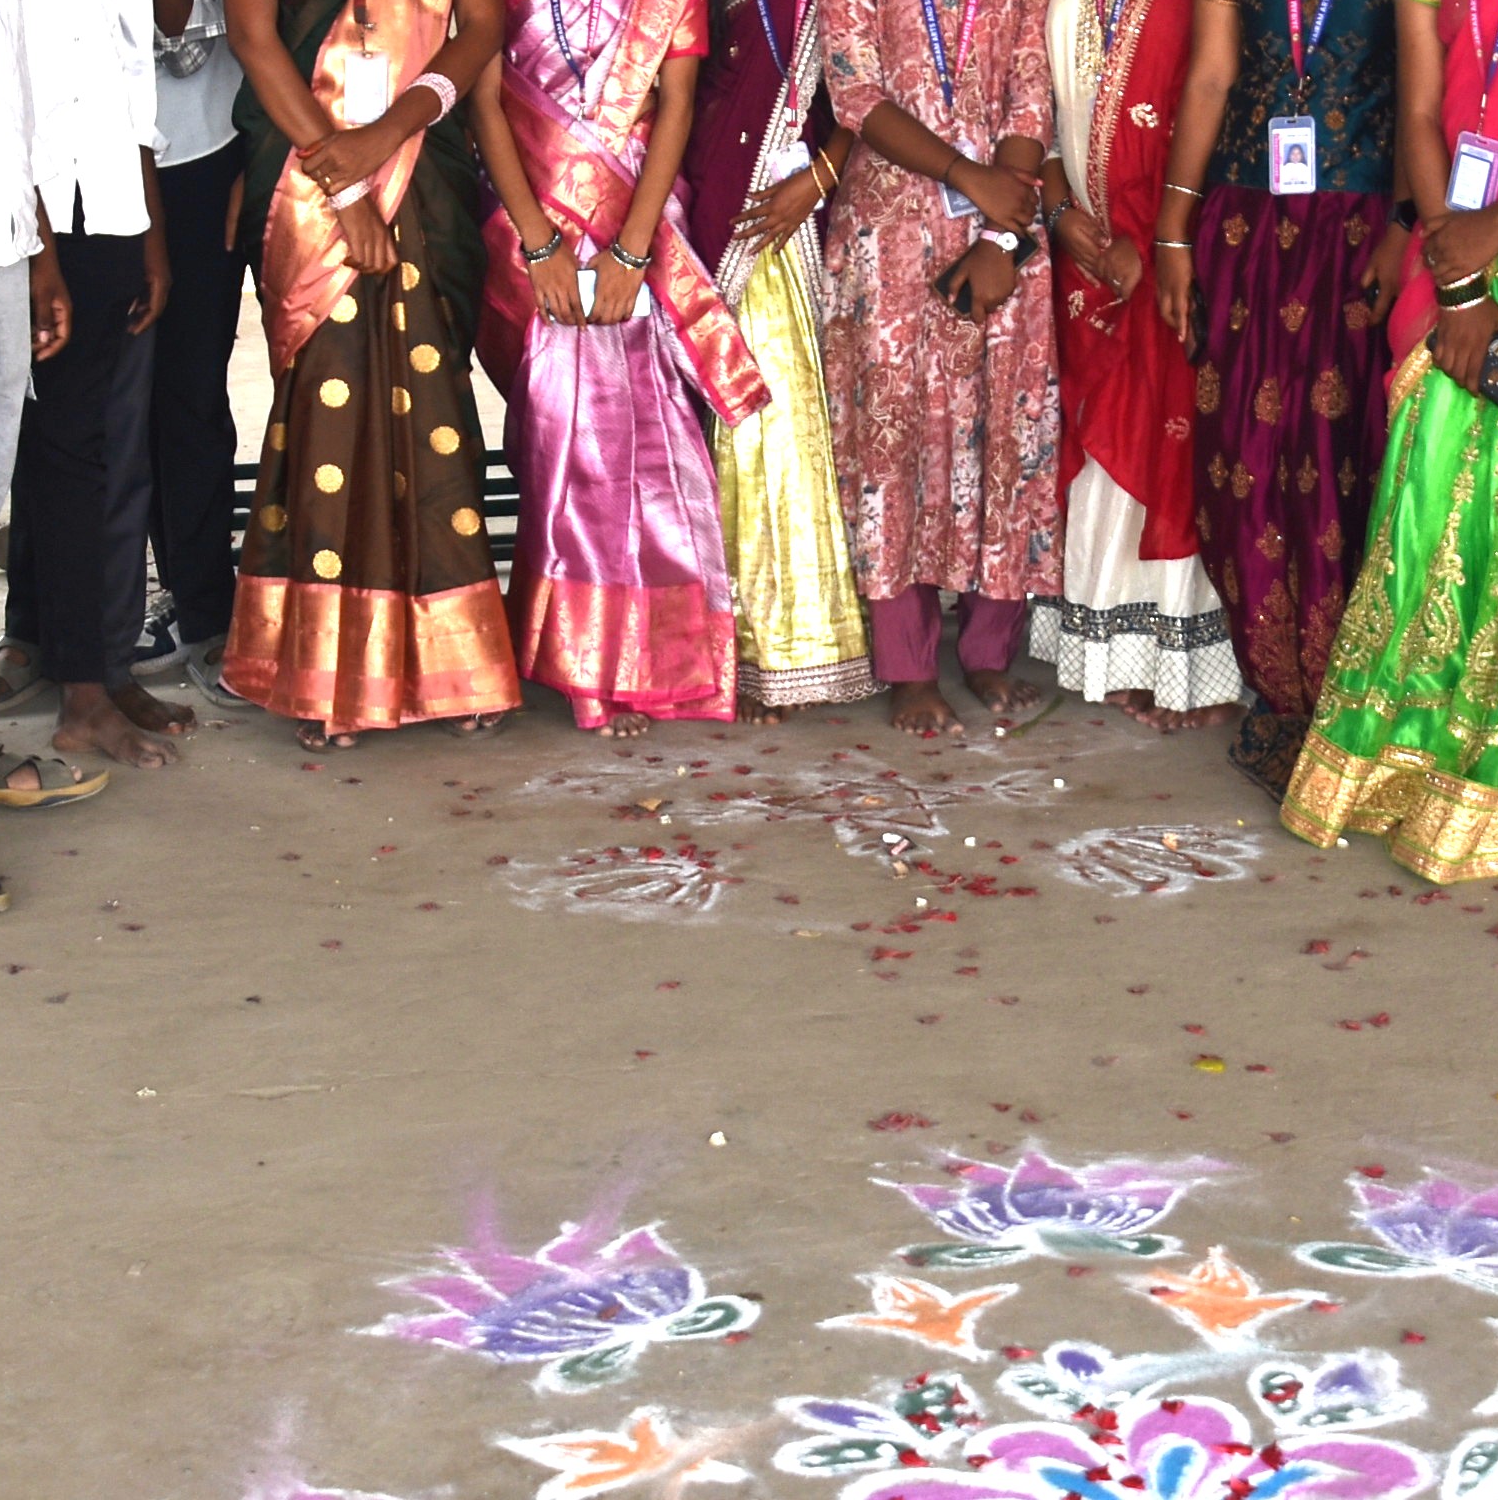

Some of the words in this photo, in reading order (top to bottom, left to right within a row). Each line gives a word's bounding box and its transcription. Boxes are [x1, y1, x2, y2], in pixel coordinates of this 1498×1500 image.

[553, 3, 561, 22] ARTS
[925, 6, 935, 22] AND
[966, 5, 975, 21] AND
[1290, 0, 1298, 29] JAIRAM
[556, 23, 568, 50] JAIRAM
[929, 23, 939, 42] ARTS
[962, 22, 972, 41] ARTS
[1312, 13, 1324, 41] JAIRAM
[933, 42, 944, 70] JAIRAM
